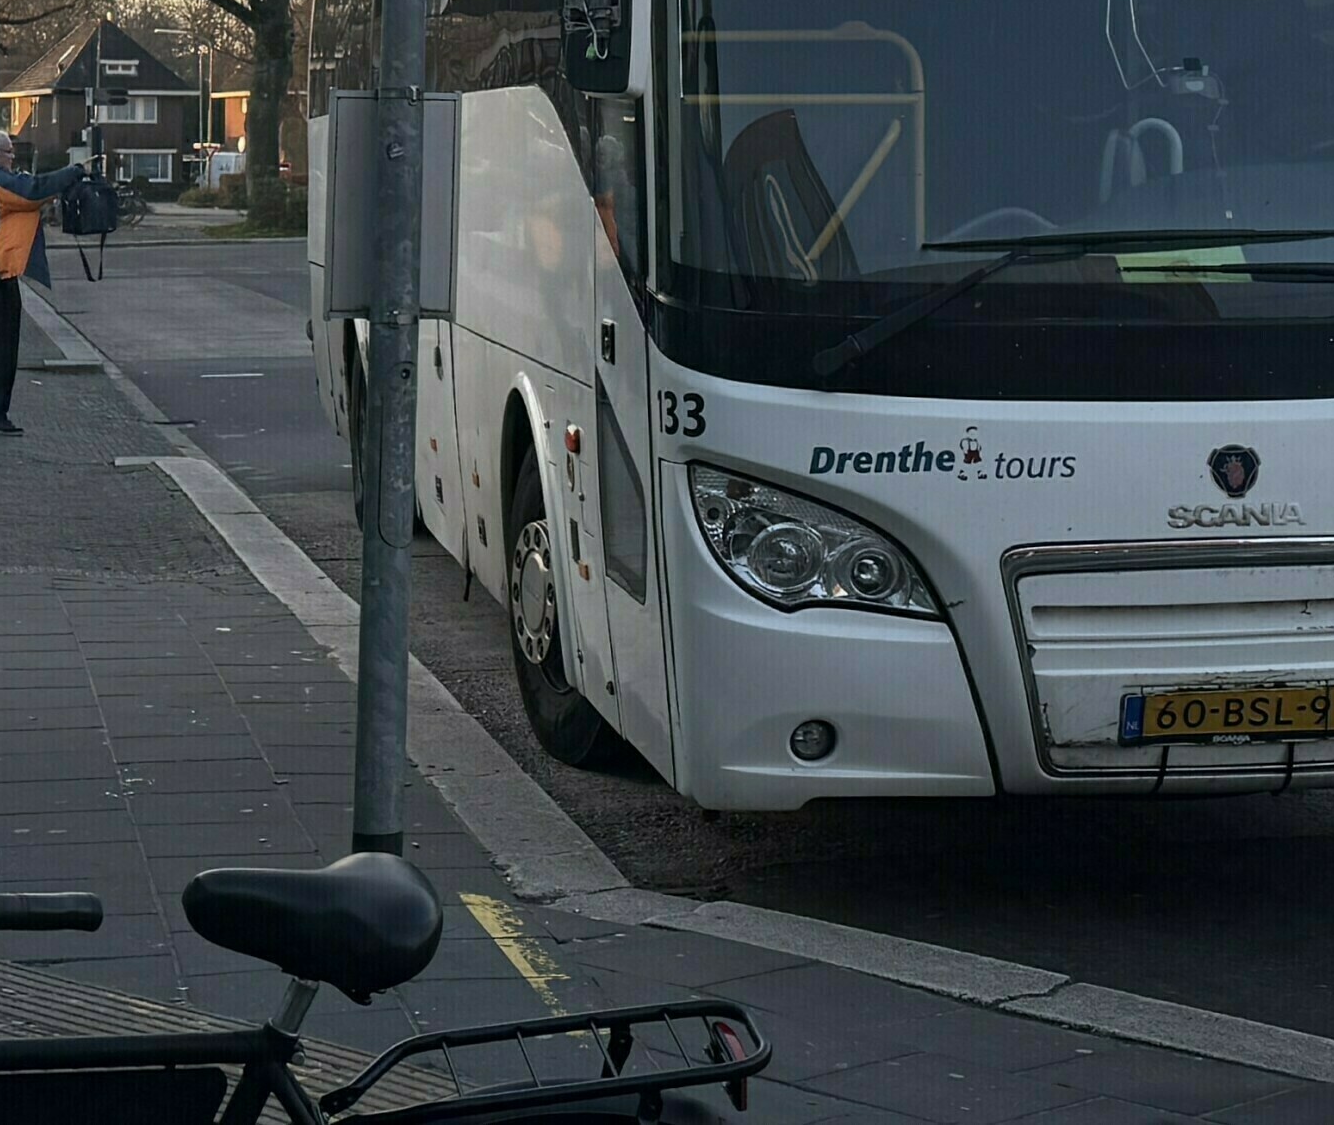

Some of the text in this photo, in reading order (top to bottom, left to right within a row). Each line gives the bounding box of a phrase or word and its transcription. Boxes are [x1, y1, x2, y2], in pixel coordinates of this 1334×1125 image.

[657, 389, 707, 438] 133
[809, 440, 1076, 480] Drenthe tours
[1167, 502, 1307, 529] SCANIA
[1126, 720, 1140, 731] NL
[1156, 695, 1331, 730] 60-BSL-9
